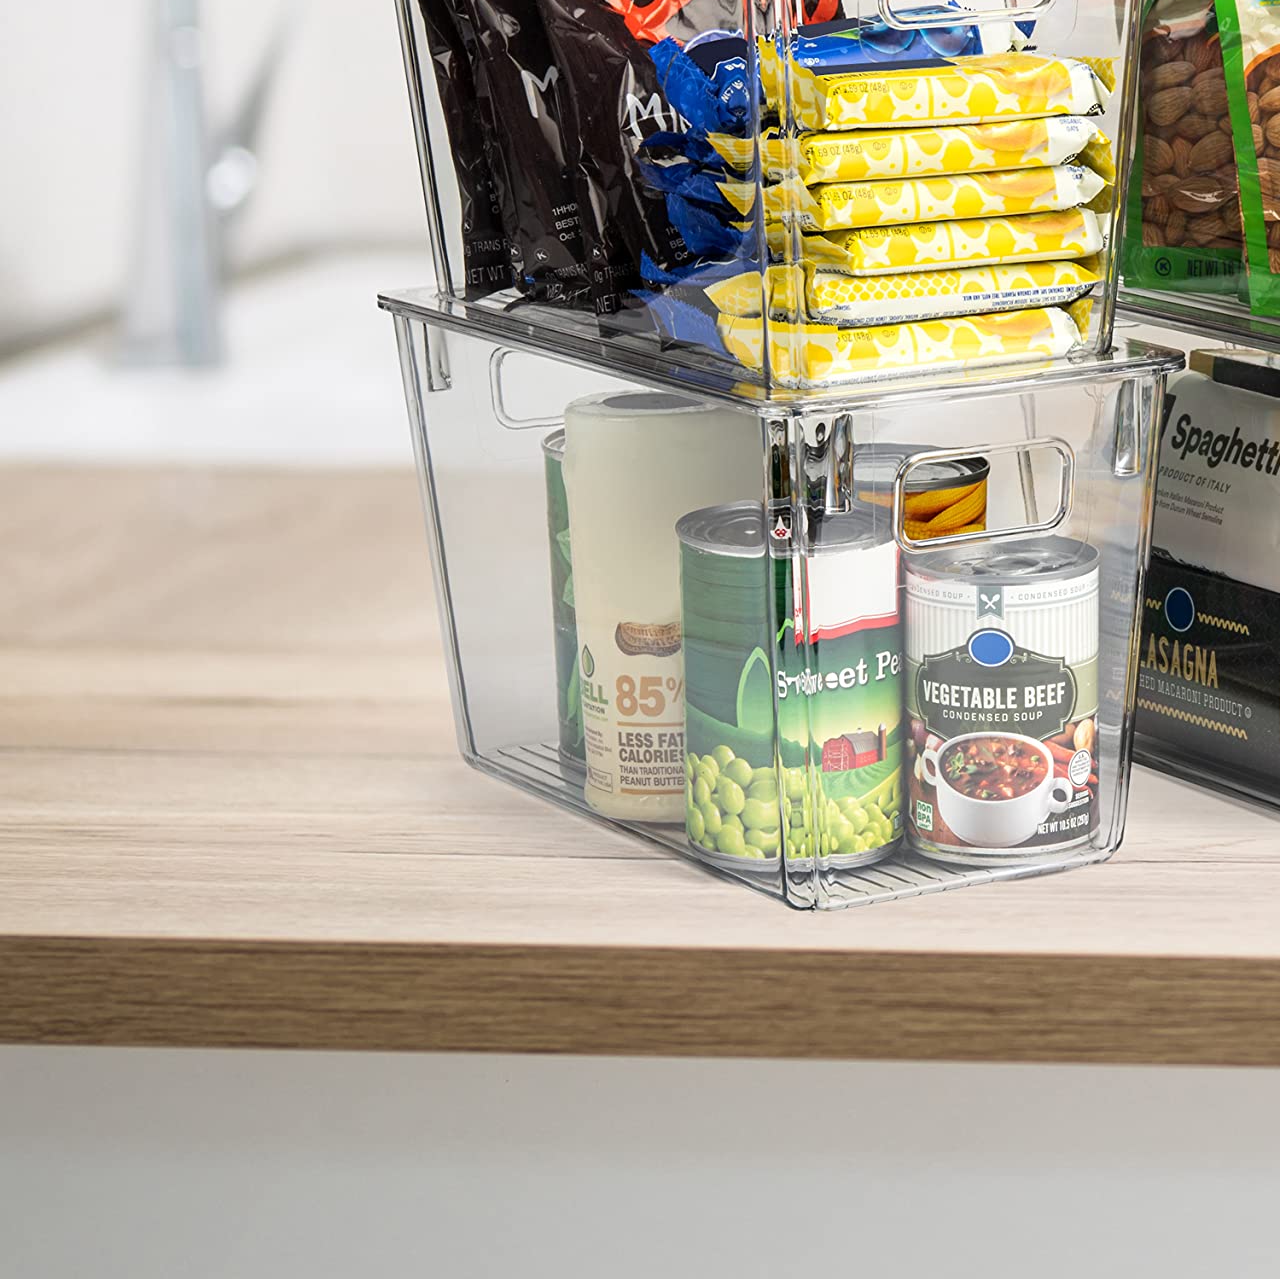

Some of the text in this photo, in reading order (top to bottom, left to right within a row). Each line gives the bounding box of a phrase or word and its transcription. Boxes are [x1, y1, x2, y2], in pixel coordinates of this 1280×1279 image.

[473, 240, 501, 252] TRANS
[596, 294, 615, 315] NET
[1196, 476, 1207, 487] OF
[1207, 479, 1232, 494] ITALY
[942, 591, 963, 600] SOUP
[1018, 588, 1068, 601] CONDENSED
[923, 679, 1066, 709] VEGETABLE BEEF
[1157, 679, 1202, 705] MACARONI
[1203, 693, 1243, 718] PRODUCT
[942, 709, 1043, 722] CONDENSED SOUP
[618, 731, 653, 748] LESS
[657, 732, 684, 748] FAT
[620, 764, 638, 775] THAN
[620, 775, 652, 786] PEANUT
[918, 802, 932, 813] non
[917, 811, 932, 825] BPA
[1037, 822, 1049, 835] NET
[1050, 821, 1058, 833] WT
